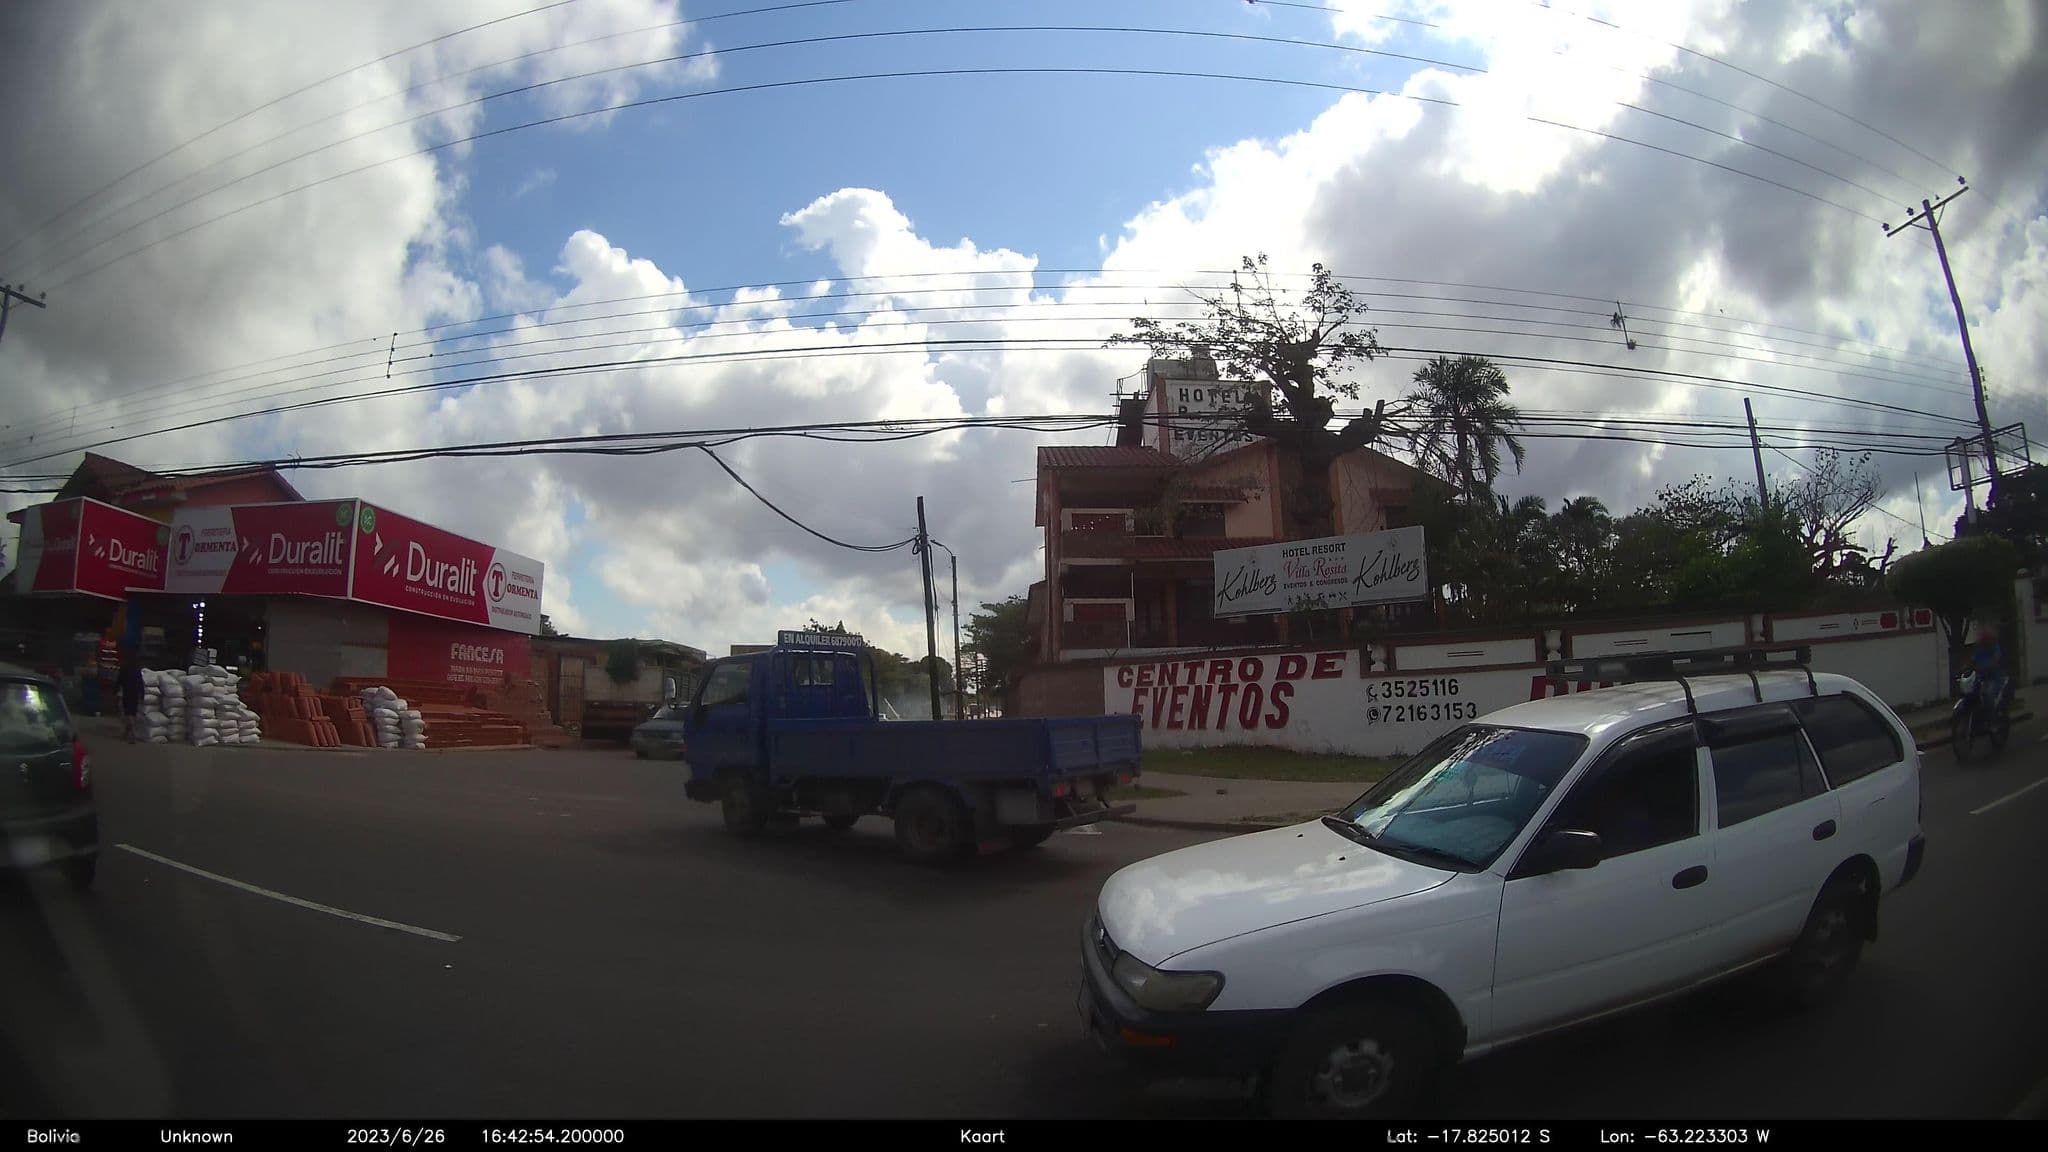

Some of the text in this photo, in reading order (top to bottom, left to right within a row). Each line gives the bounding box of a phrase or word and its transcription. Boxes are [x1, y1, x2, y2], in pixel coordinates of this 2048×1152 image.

[1179, 387, 1245, 403] HOTEL
[109, 538, 159, 572] Duralit
[268, 531, 345, 565] Duralit
[1281, 542, 1347, 559] HOTEL RESORT
[406, 540, 480, 597] Duralit
[1283, 557, 1347, 579] Villa Rosita
[1352, 550, 1420, 596] Kohlberg
[1216, 565, 1277, 608] Kohlberg
[783, 632, 794, 644] EN
[795, 633, 831, 646] ALQUILER
[1117, 652, 1347, 688] CENTRO DE
[1132, 681, 1295, 730] EVENTOS
[1381, 678, 1459, 699] 3525116
[1382, 702, 1477, 723] 72163153
